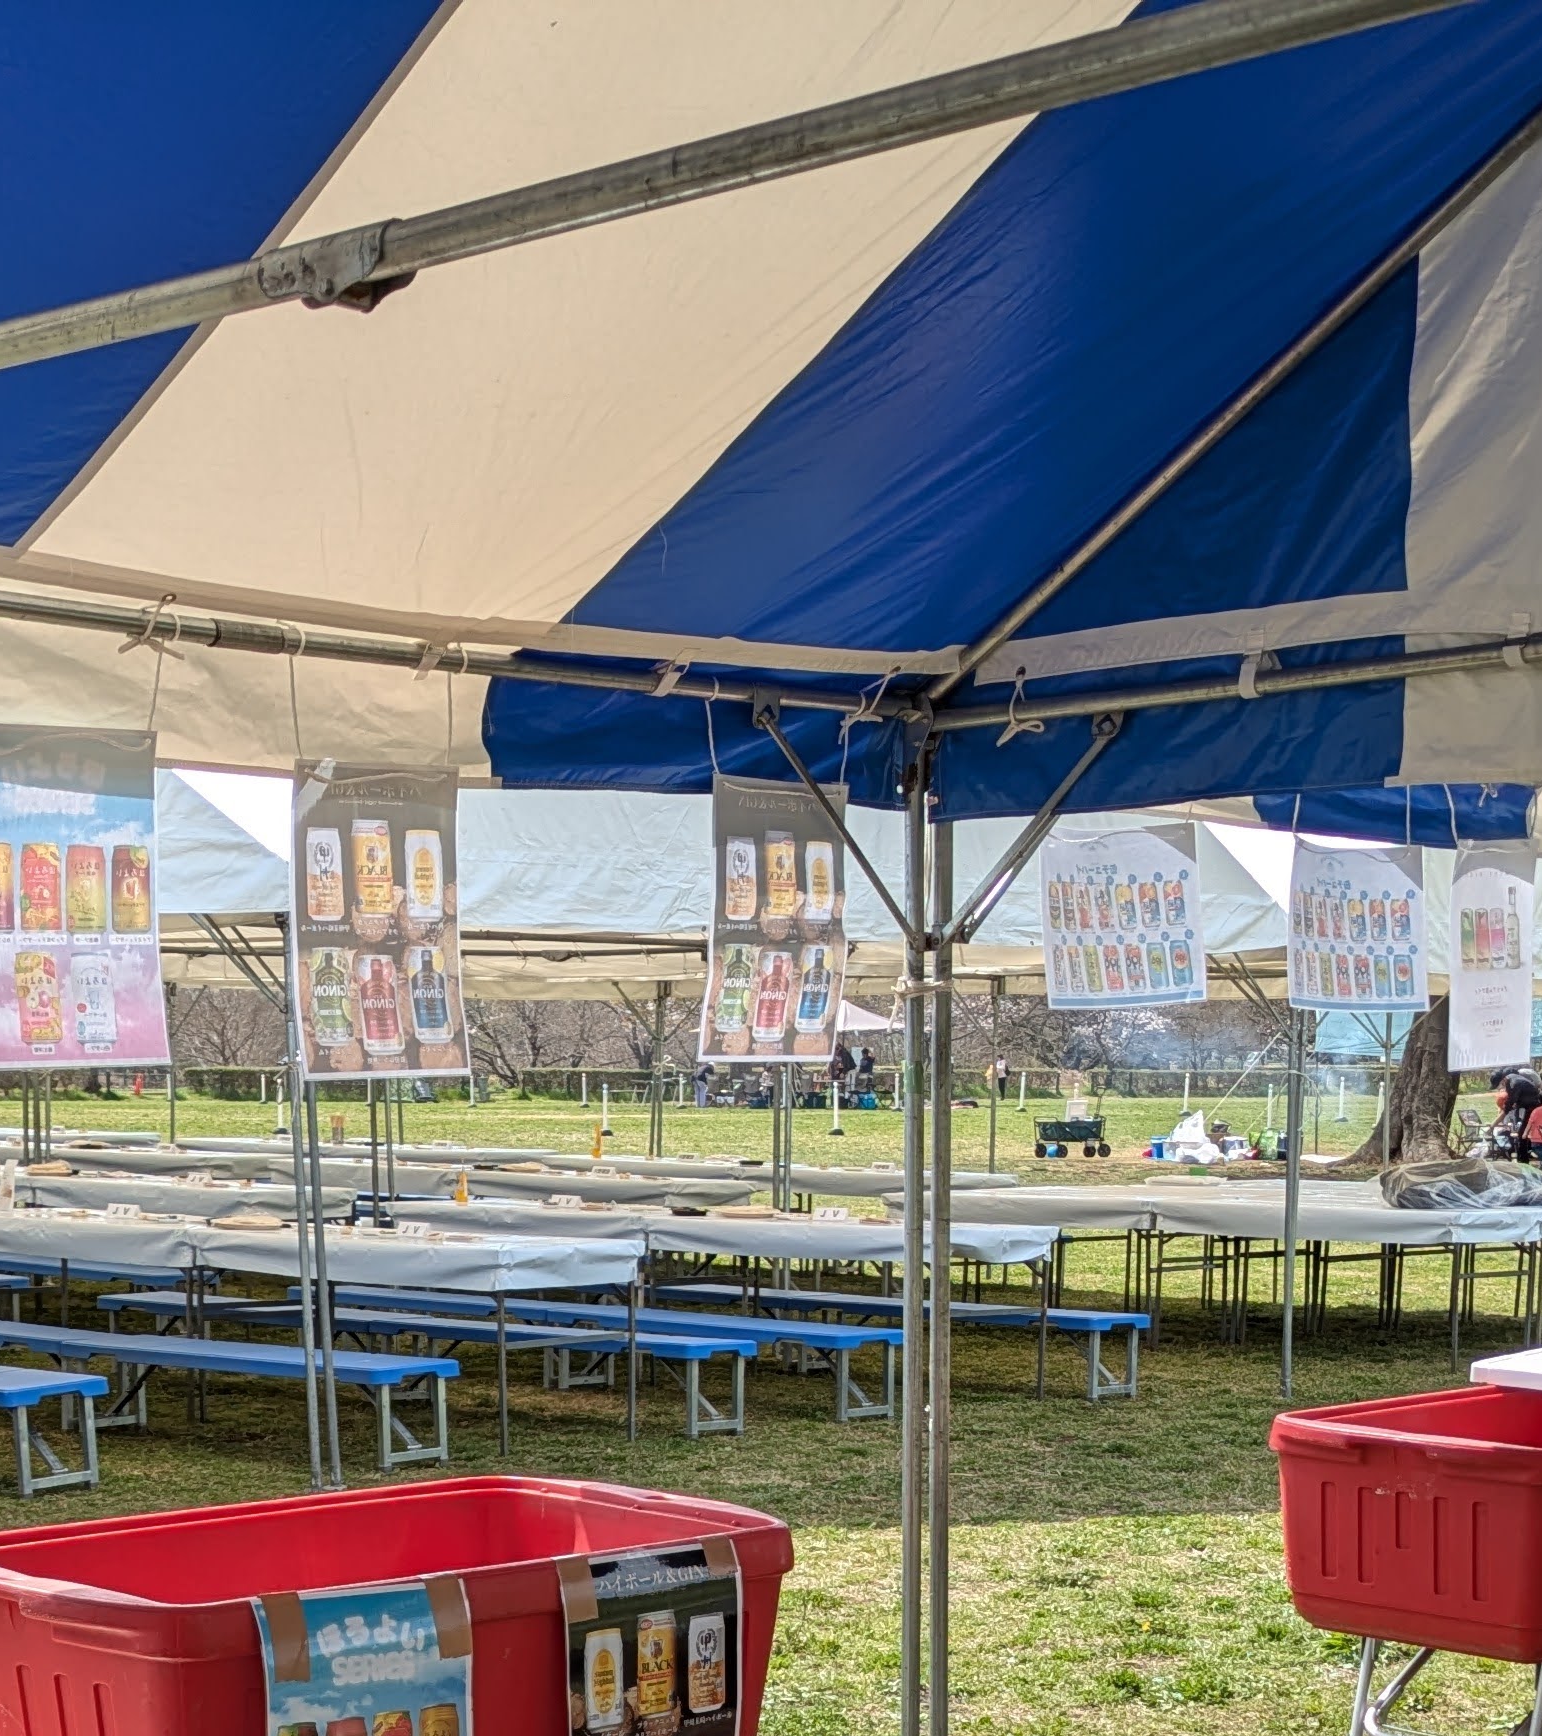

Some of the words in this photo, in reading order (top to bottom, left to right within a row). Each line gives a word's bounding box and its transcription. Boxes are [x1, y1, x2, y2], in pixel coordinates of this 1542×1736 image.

[317, 1614, 425, 1655] ほろよい
[641, 1659, 674, 1673] BLACK
